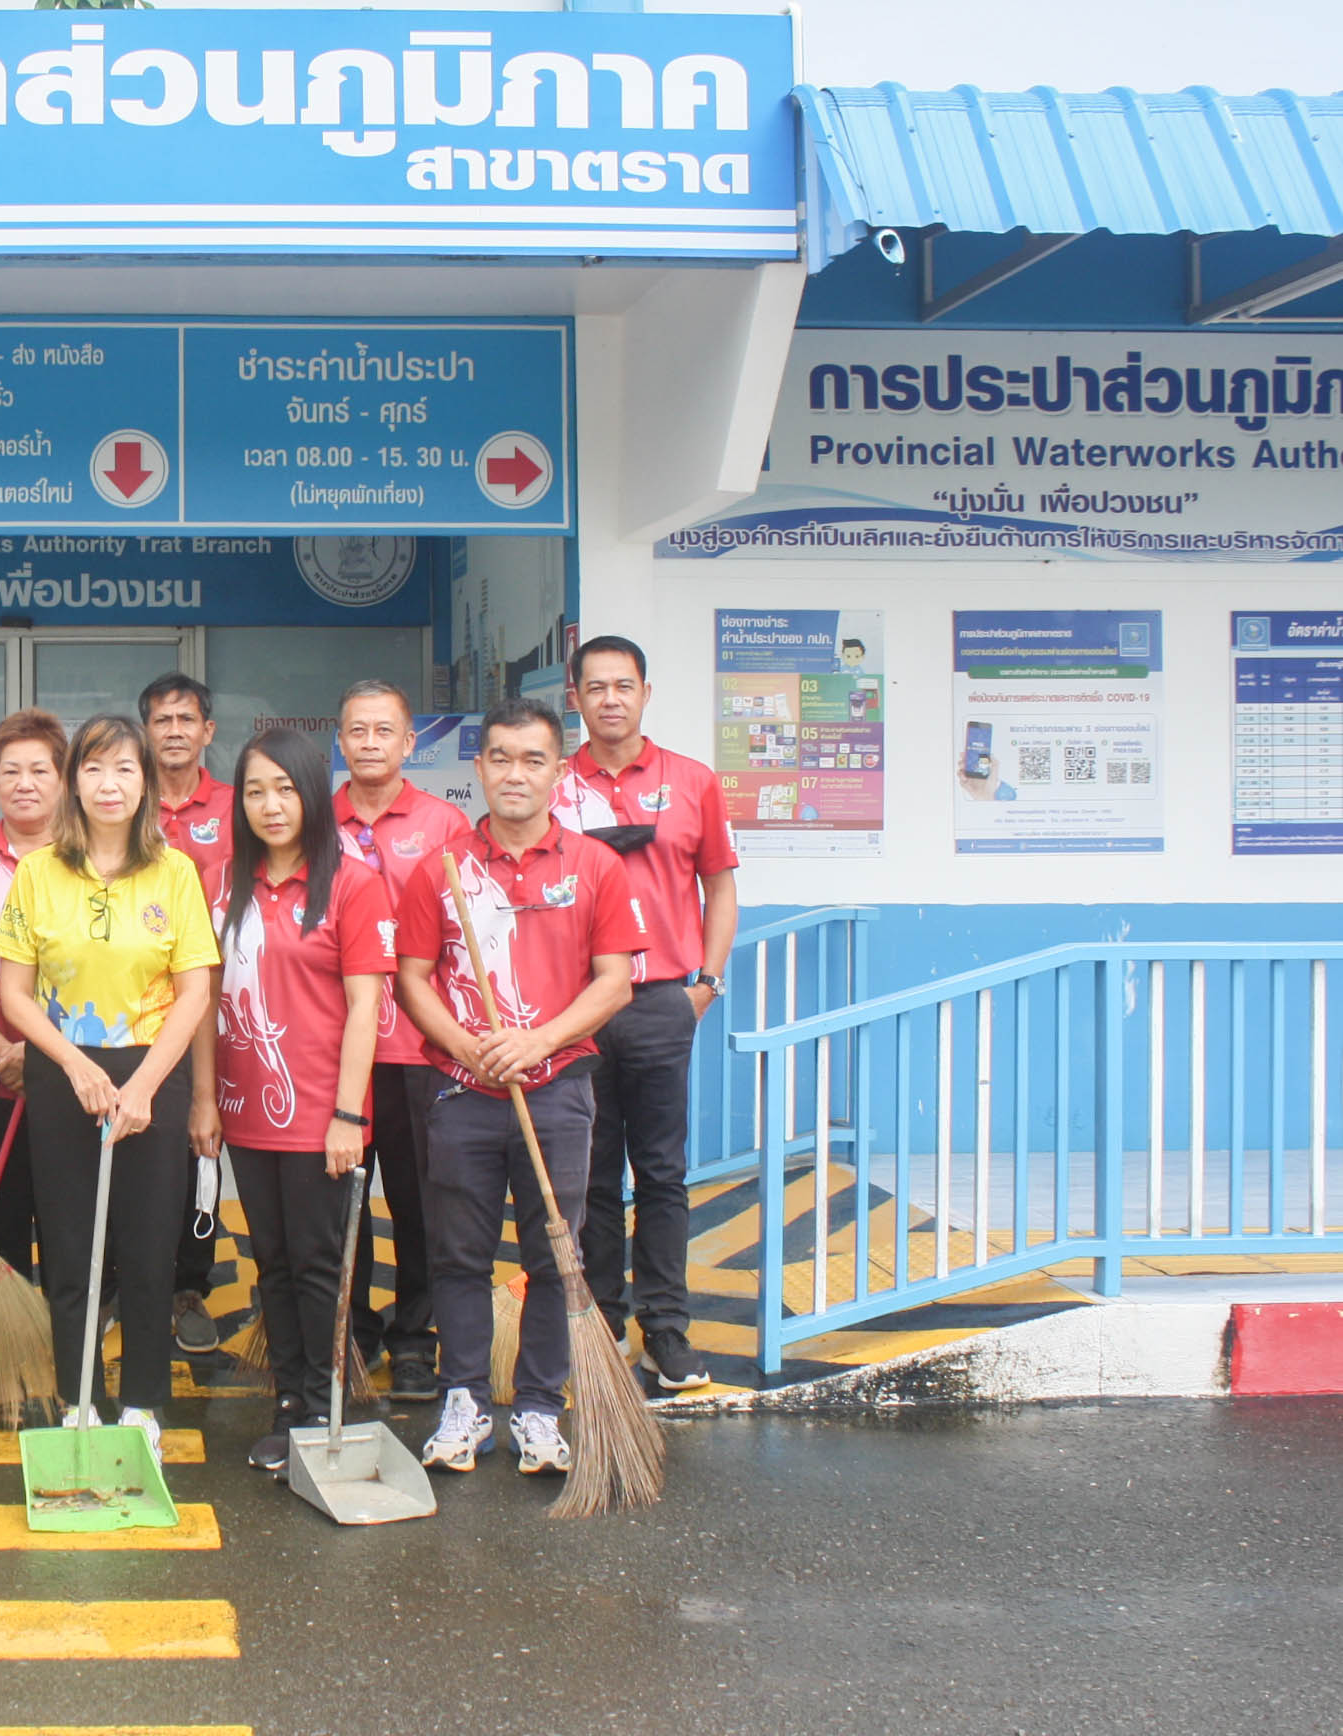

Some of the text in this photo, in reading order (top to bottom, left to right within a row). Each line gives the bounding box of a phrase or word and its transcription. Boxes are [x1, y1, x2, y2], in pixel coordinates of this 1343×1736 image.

[406, 145, 750, 195] สาขาตราด
[11, 343, 36, 365] ส่ง
[43, 343, 105, 366] หนังสือ
[238, 341, 475, 382] ชำระค่าน้ำประปา
[285, 395, 350, 424] จันทร์
[379, 395, 428, 433] ศุกร์
[244, 448, 288, 467] เวลา
[296, 446, 353, 467] 08.00
[810, 434, 1343, 469] Provincial Waterworks Auth
[22, 535, 127, 557] Authority
[135, 535, 182, 553] Trat
[191, 535, 272, 554] Branch
[801, 680, 818, 692] 03
[1107, 693, 1150, 702] COVID-19
[721, 727, 739, 739] 04
[801, 728, 818, 740] 05
[721, 777, 739, 788] 06
[801, 777, 818, 789] 07
